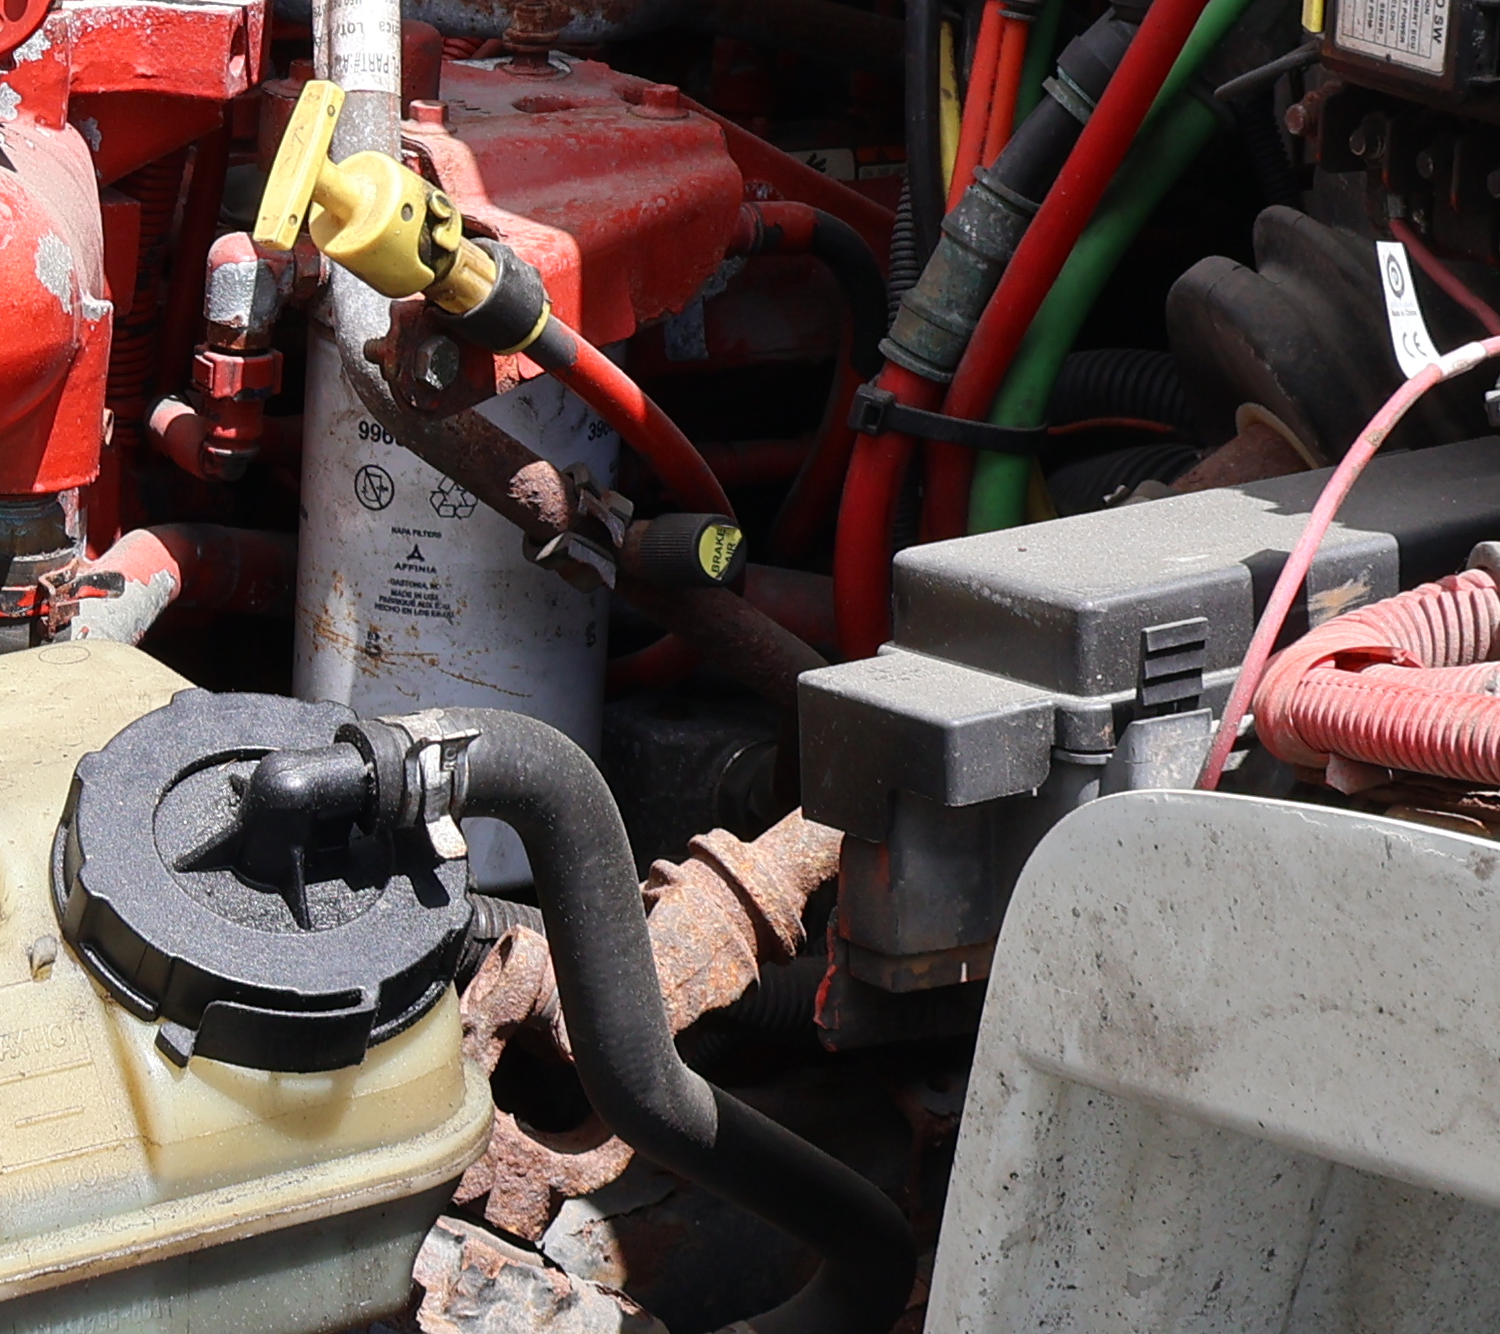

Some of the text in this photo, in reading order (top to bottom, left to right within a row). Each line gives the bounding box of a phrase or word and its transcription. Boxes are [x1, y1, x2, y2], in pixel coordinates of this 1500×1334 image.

[1433, 15, 1444, 44] SW
[391, 527, 442, 538] NAPA FILTERS
[711, 528, 725, 573] BRAKE
[725, 542, 736, 562] AIR
[394, 562, 437, 574] AFFINIA
[391, 589, 412, 598] MADE
